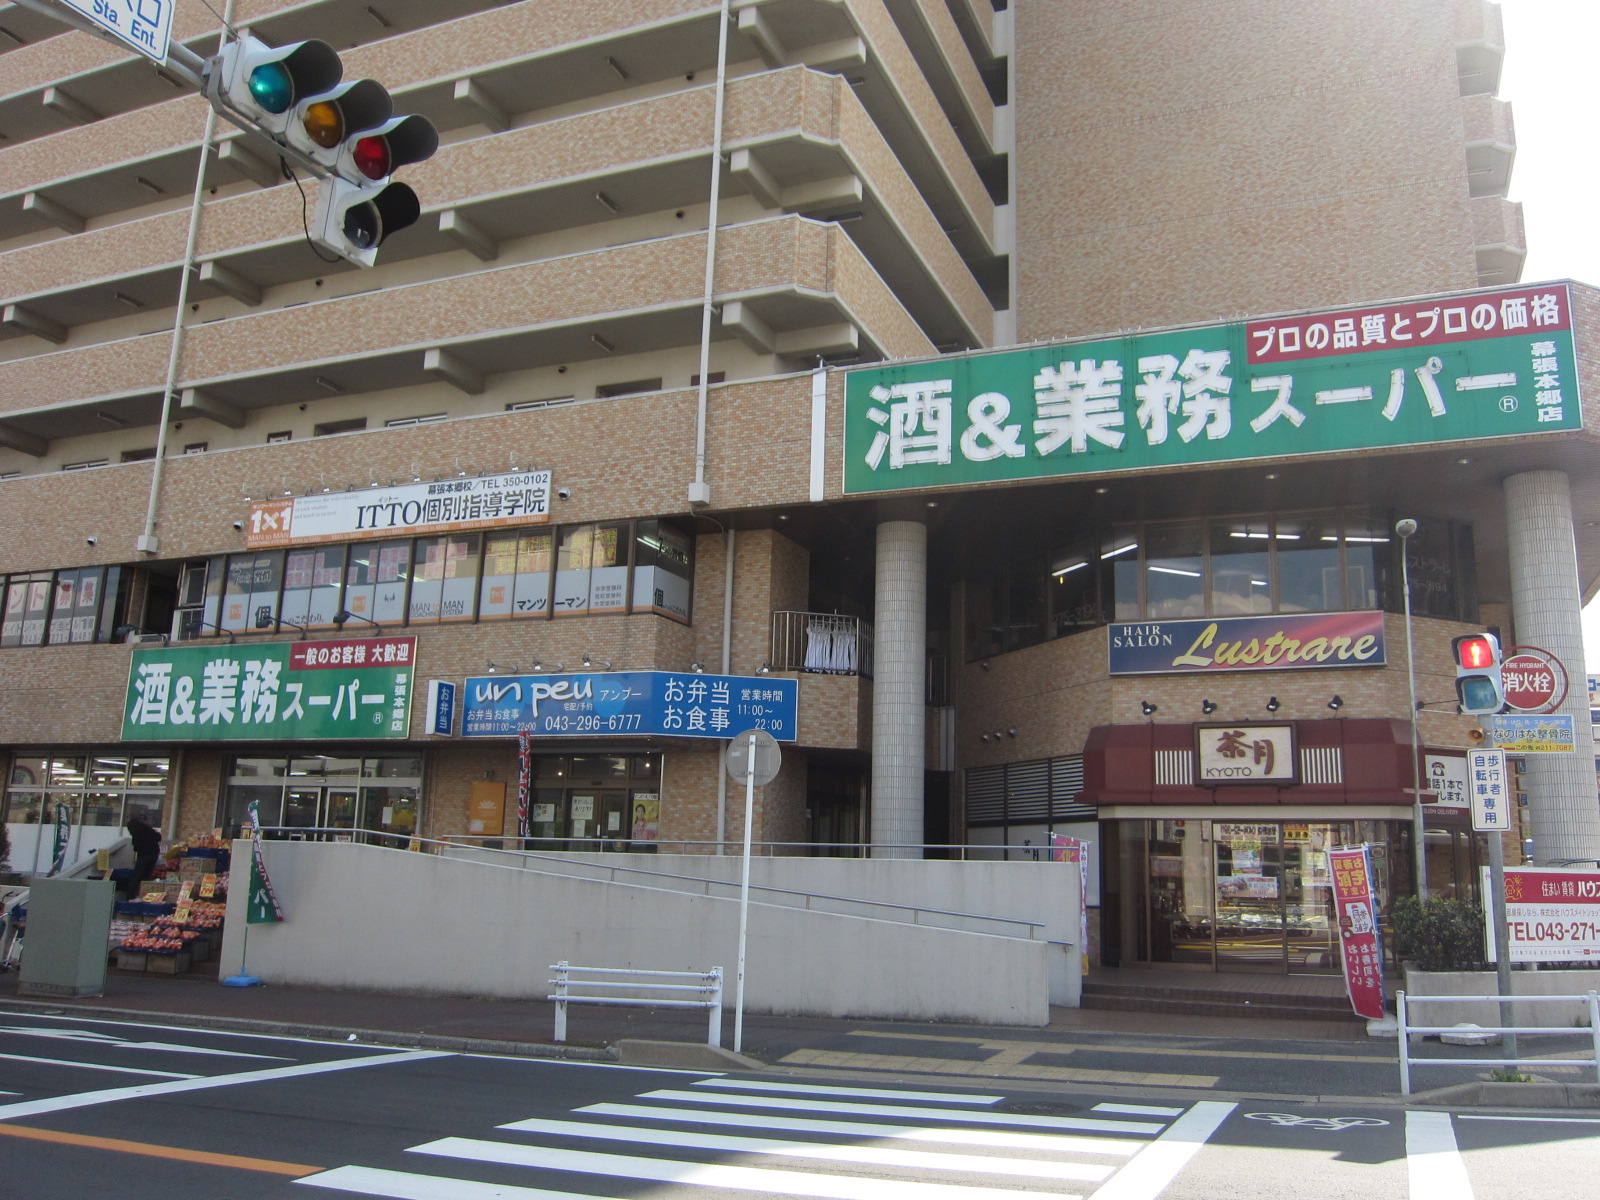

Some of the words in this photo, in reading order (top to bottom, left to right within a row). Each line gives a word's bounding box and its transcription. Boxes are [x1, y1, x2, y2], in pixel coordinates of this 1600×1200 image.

[93, 0, 120, 27] Sta.
[131, 19, 157, 50] Ent.
[1252, 294, 1559, 357] プロの品質とプロの価格
[1530, 341, 1563, 422] 幕張本郷店
[865, 349, 1516, 471] 酒&業務スーパー
[503, 473, 548, 487] 350-0102
[411, 603, 431, 612] MAN
[443, 600, 464, 609] MAN
[1113, 634, 1172, 648] SALON
[1123, 625, 1161, 636] HAIR
[295, 645, 366, 665] 一般のお客様
[371, 643, 409, 662] 大歓迎
[1172, 622, 1378, 667] Lustrare
[130, 658, 385, 725] 酒&業務スーパー
[664, 677, 730, 705] お弁当
[1502, 672, 1551, 692] 消火栓
[391, 673, 407, 731] 幕張本郷店
[475, 681, 521, 701] un
[530, 678, 592, 718] peu
[600, 687, 642, 701] アンプー
[740, 689, 783, 702] 営業時間
[439, 686, 450, 729] お弁当
[467, 709, 493, 720] お弁当
[494, 708, 519, 720] お食事
[563, 703, 593, 711] 宅配/予約
[545, 714, 641, 731] 043-296-6777
[663, 705, 730, 732] お食事
[755, 719, 783, 730] 22:00
[1493, 728, 1571, 739] なのはな整骨院
[1205, 766, 1252, 777] KYOTO
[1475, 755, 1488, 795] 自転車
[1488, 755, 1501, 795] 歩行者
[1483, 798, 1497, 823] 専用
[1541, 880, 1560, 896] 住まい
[1561, 880, 1575, 896] 賃貸
